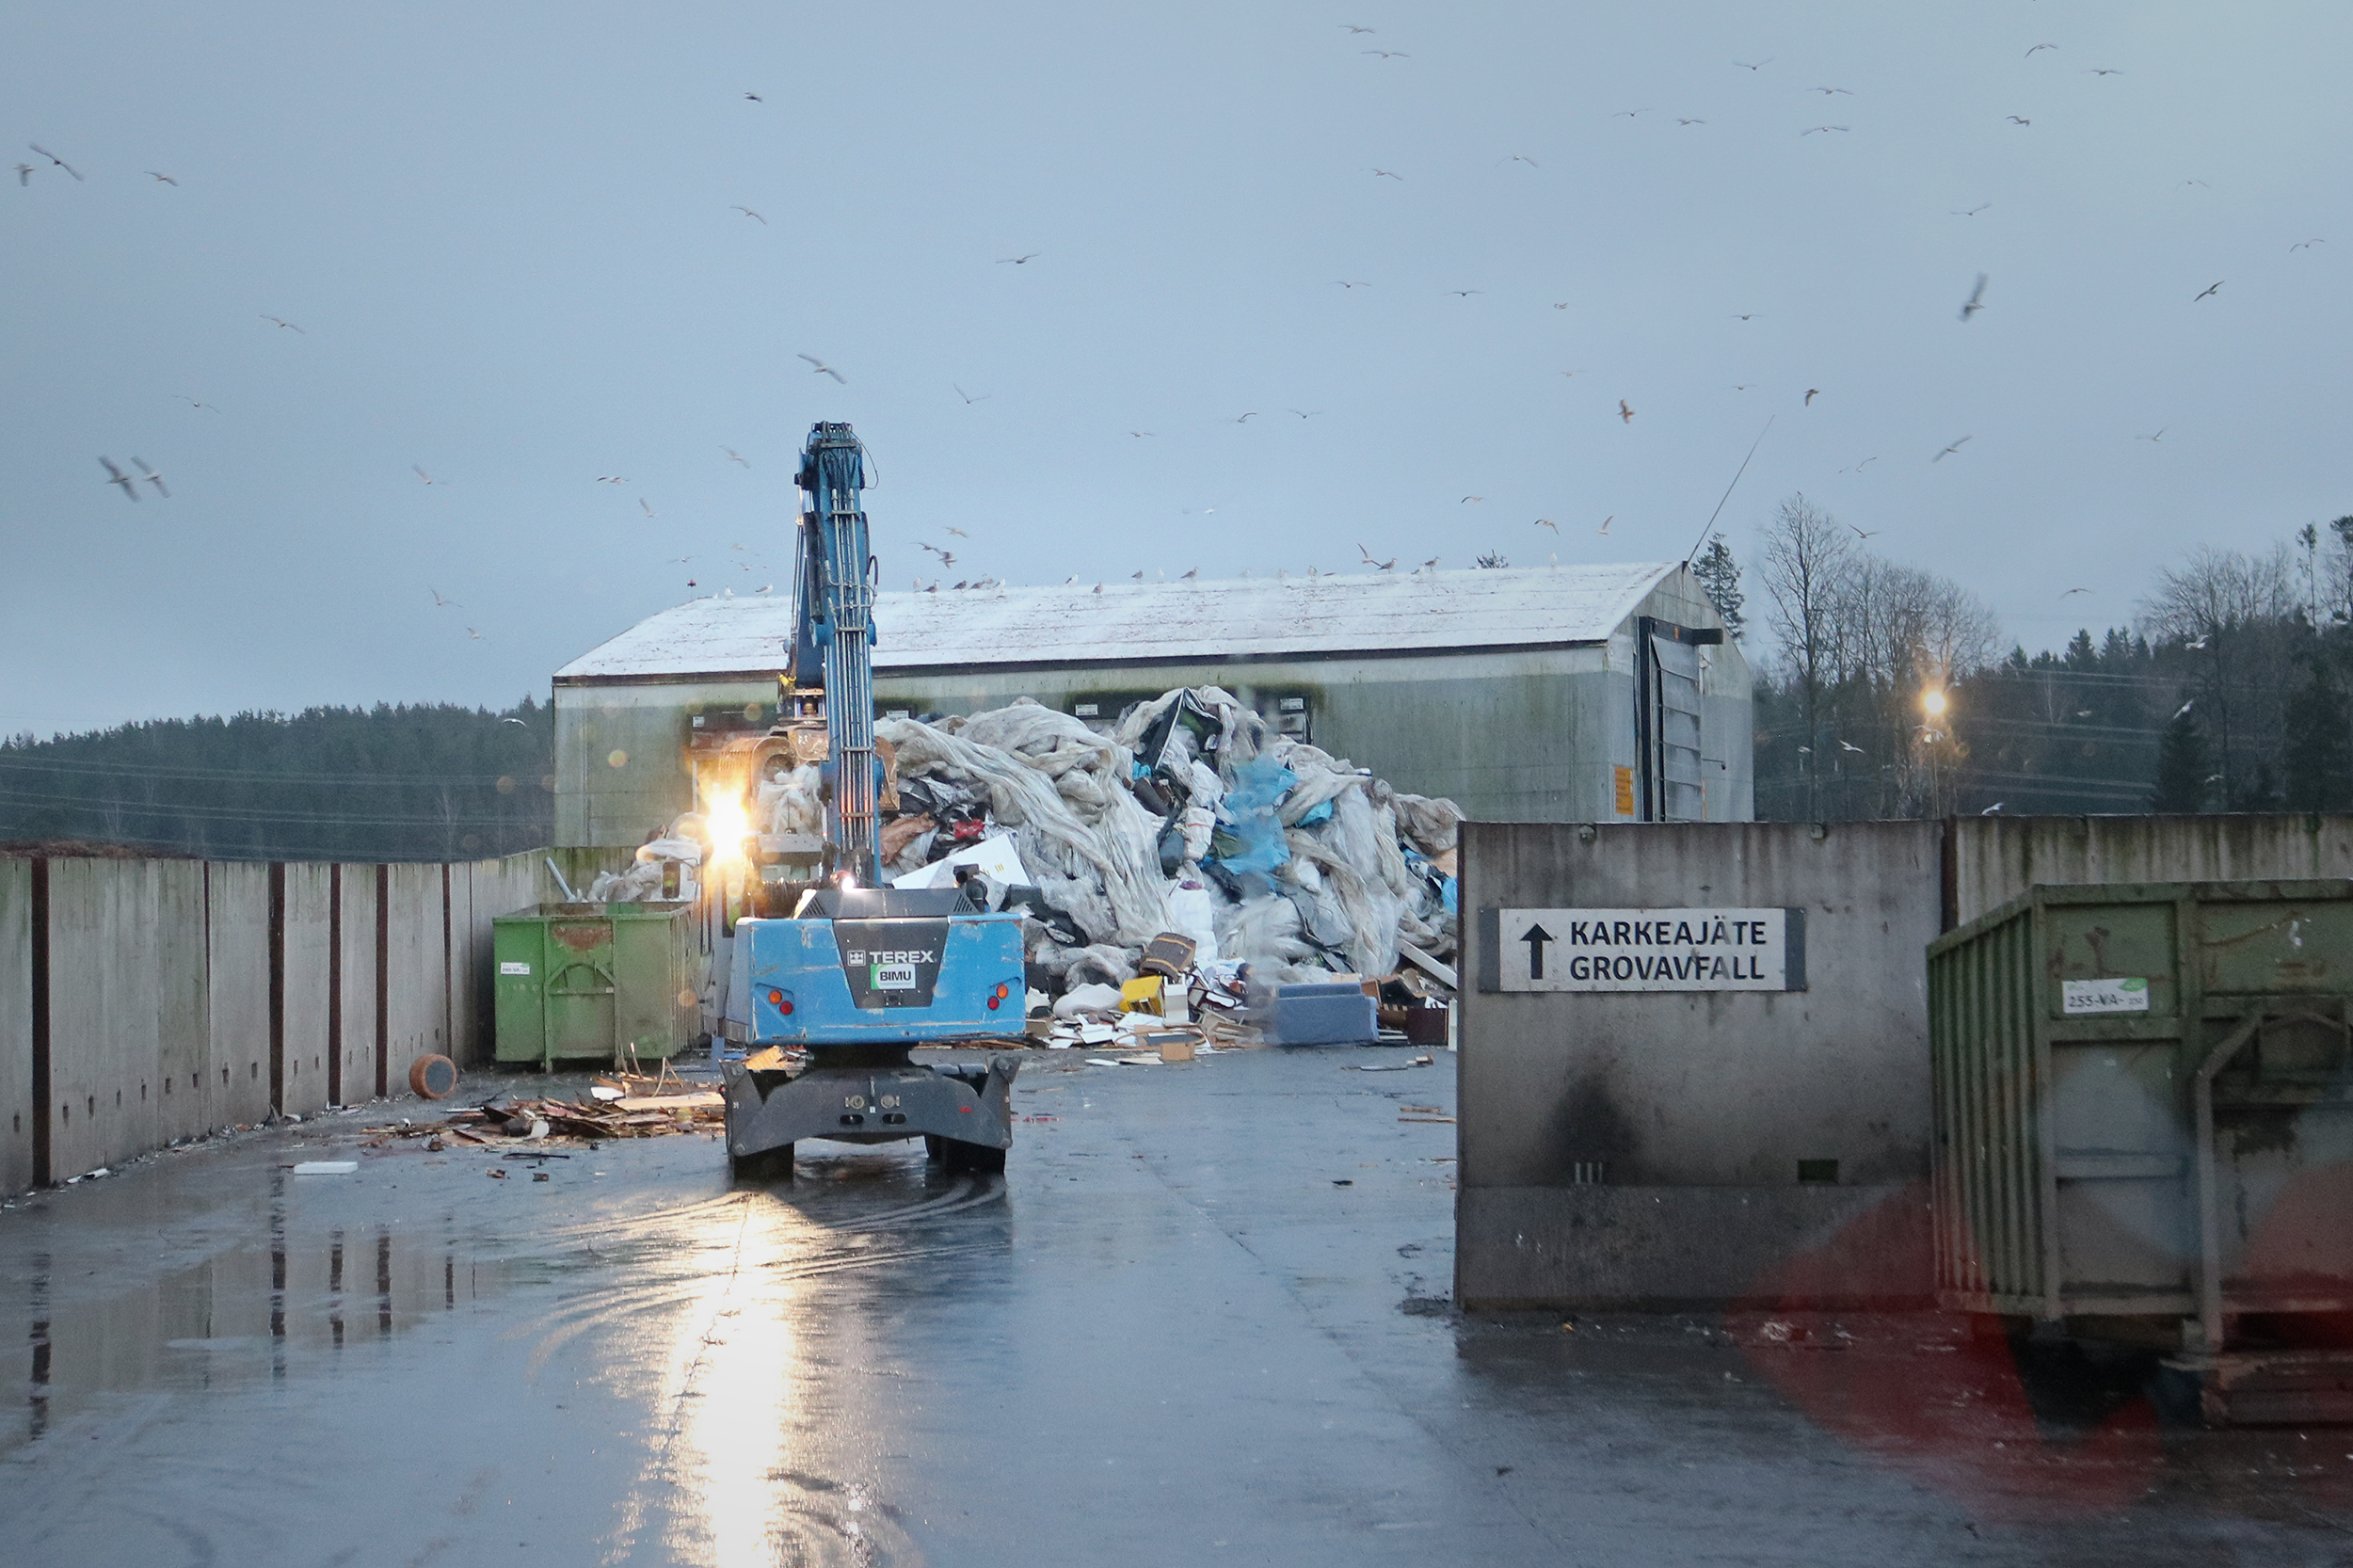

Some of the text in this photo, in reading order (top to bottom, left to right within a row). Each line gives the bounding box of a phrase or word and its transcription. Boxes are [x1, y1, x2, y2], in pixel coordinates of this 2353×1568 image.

[1571, 915, 1767, 946] KARKEAJÄTE
[869, 950, 935, 964] TEREX
[879, 971, 911, 982] BIMU
[1570, 956, 1766, 981] GROVAVFALL
